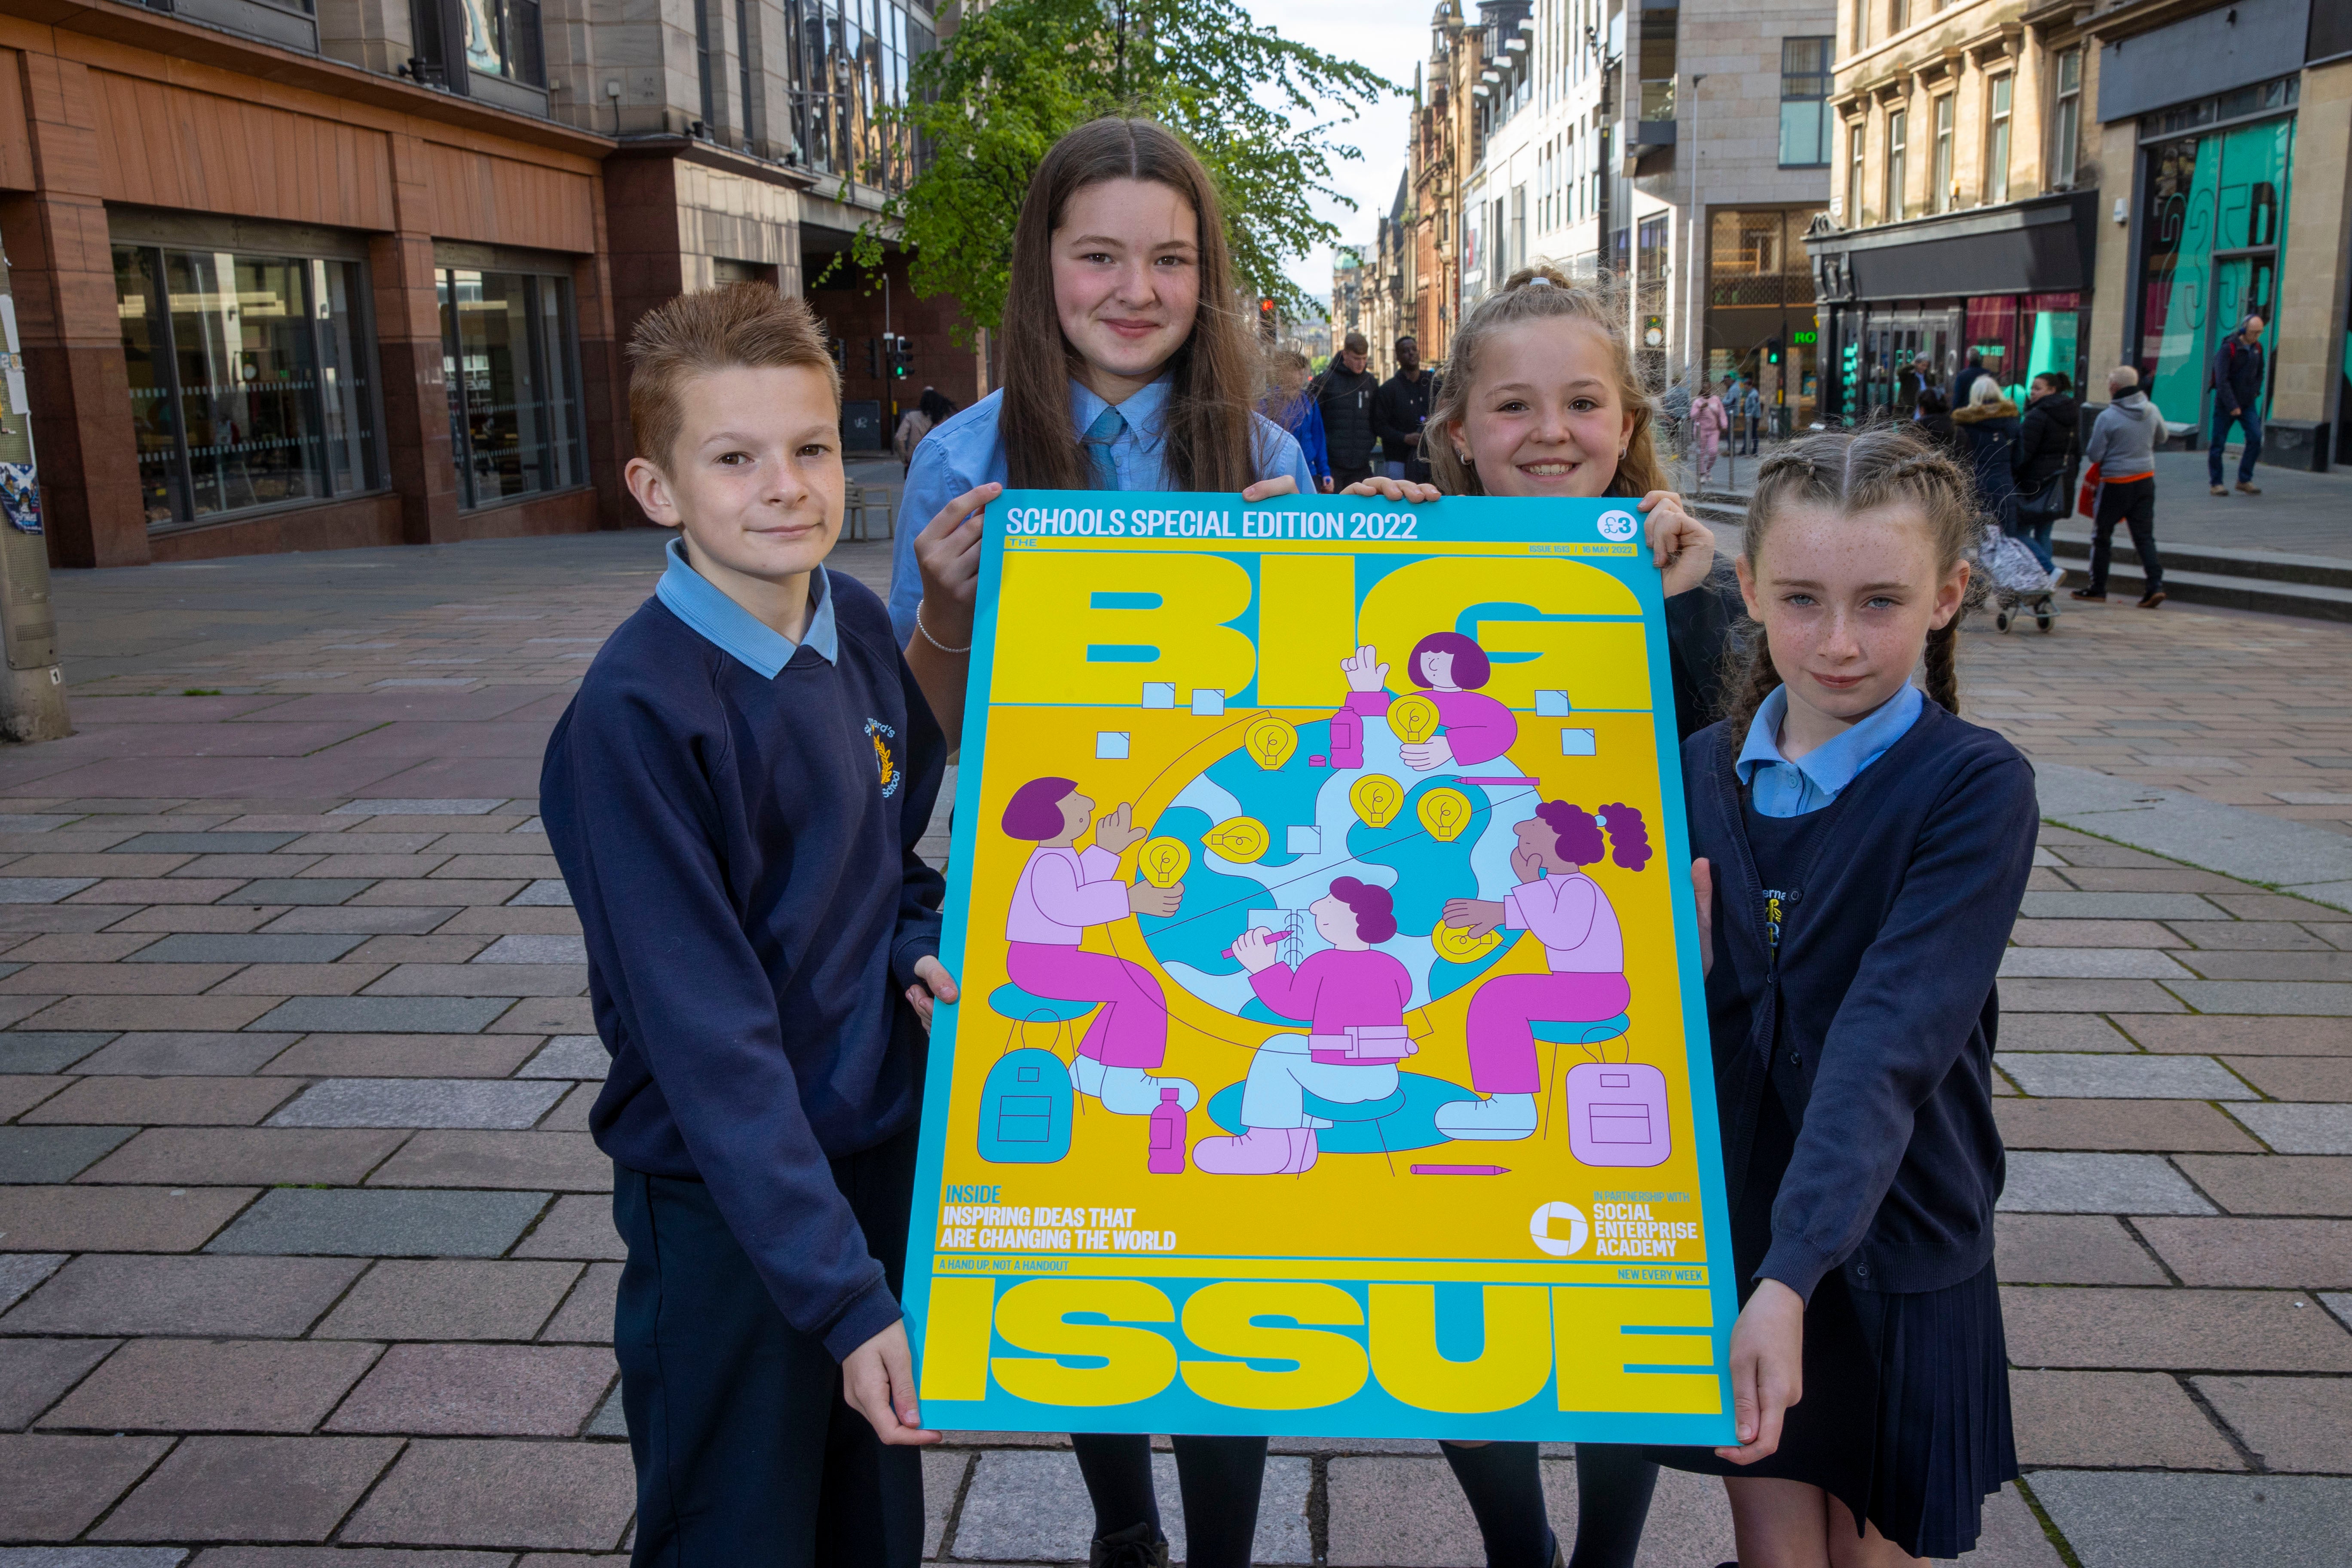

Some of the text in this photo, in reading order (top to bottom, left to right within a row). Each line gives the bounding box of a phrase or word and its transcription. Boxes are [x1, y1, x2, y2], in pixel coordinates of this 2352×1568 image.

[1794, 331, 1818, 343] RO
[1006, 508, 1418, 539] SCHOOLS SPECIAL EDITION 2022
[1604, 517, 1632, 533] £3
[1009, 538, 1037, 547] THE
[989, 551, 1653, 710] BIG
[53, 671, 58, 681] 1
[882, 770, 900, 798] School
[945, 1185, 1002, 1204] INSIDE
[1593, 1191, 1690, 1202] IN PARTNERSHIP WITH
[943, 1206, 1136, 1228] INSPIRING IDEAS THAT
[1593, 1203, 1654, 1220] SOCIAL
[1595, 1221, 1698, 1239] ENTERPRISE
[940, 1228, 1176, 1251] ARE CHANGING THE WORLD
[1596, 1240, 1677, 1256] ACADEMY
[939, 1259, 1069, 1271] A HAND UP, NOT A HANDOUT
[1618, 1269, 1703, 1281] NEW EVERY WEEK
[919, 1277, 1722, 1414] ISSUE
